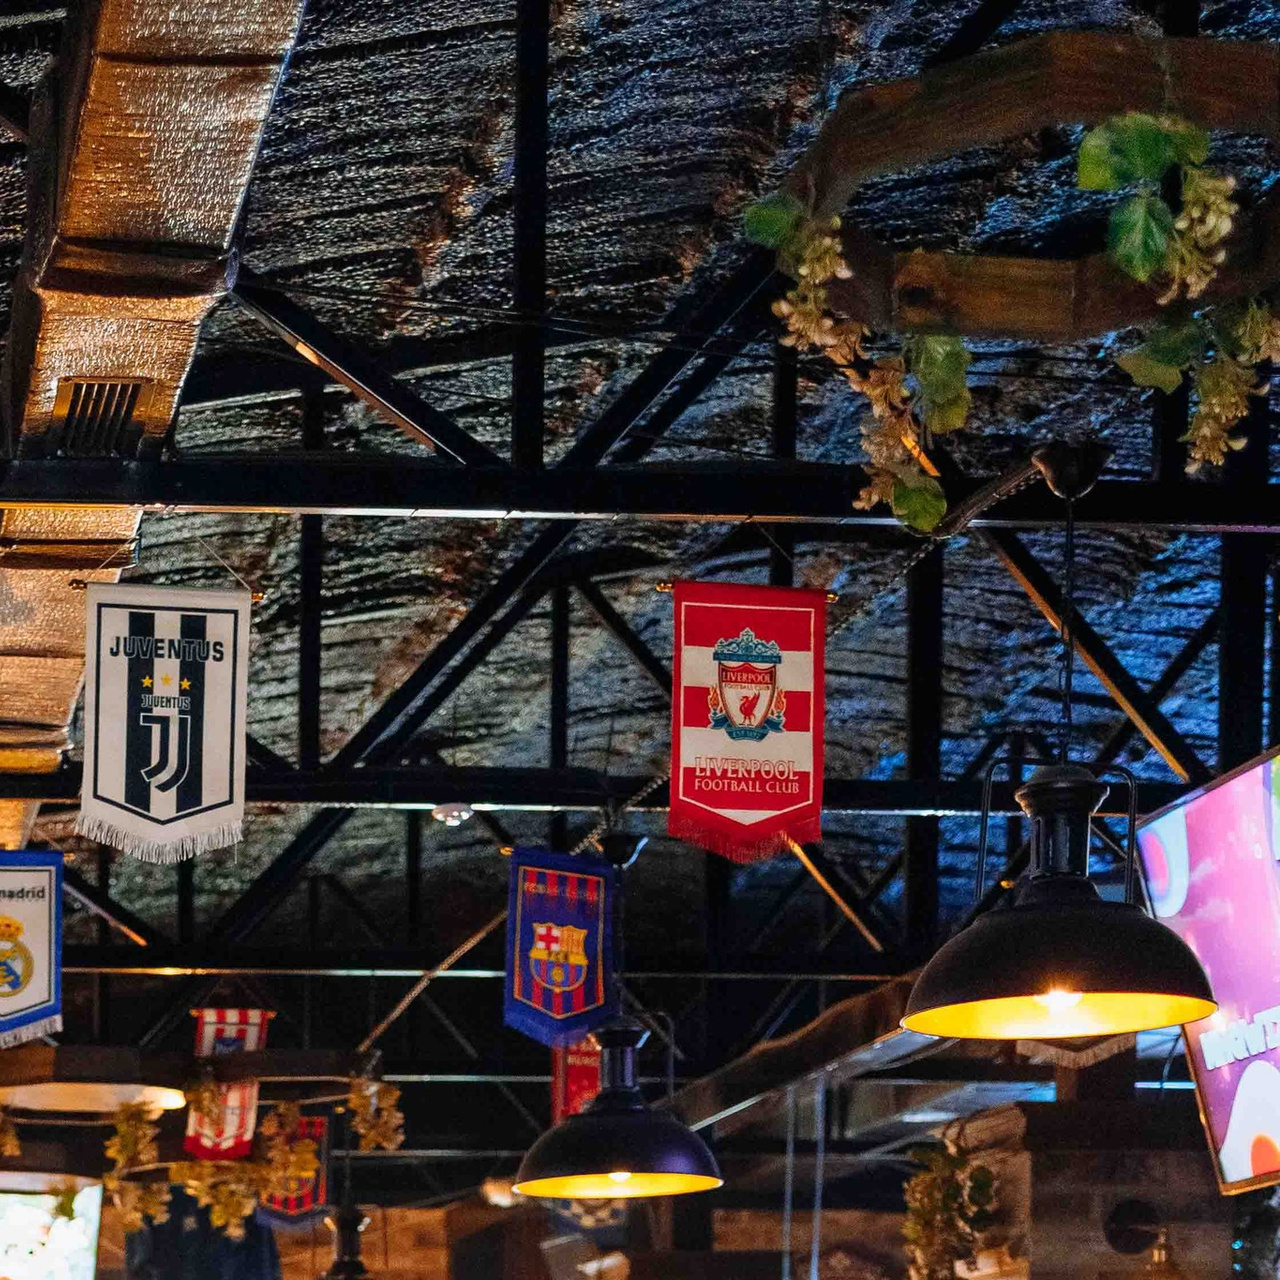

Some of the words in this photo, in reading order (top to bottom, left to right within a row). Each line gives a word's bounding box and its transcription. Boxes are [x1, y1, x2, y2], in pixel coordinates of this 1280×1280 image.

[109, 636, 225, 663] JUVENTUS
[722, 671, 773, 684] LIVERPOOL
[141, 694, 191, 710] JUVENTUS
[694, 757, 799, 780] LIVERPOOL
[694, 778, 762, 793] FOOTBALL
[765, 780, 800, 794] CLUB
